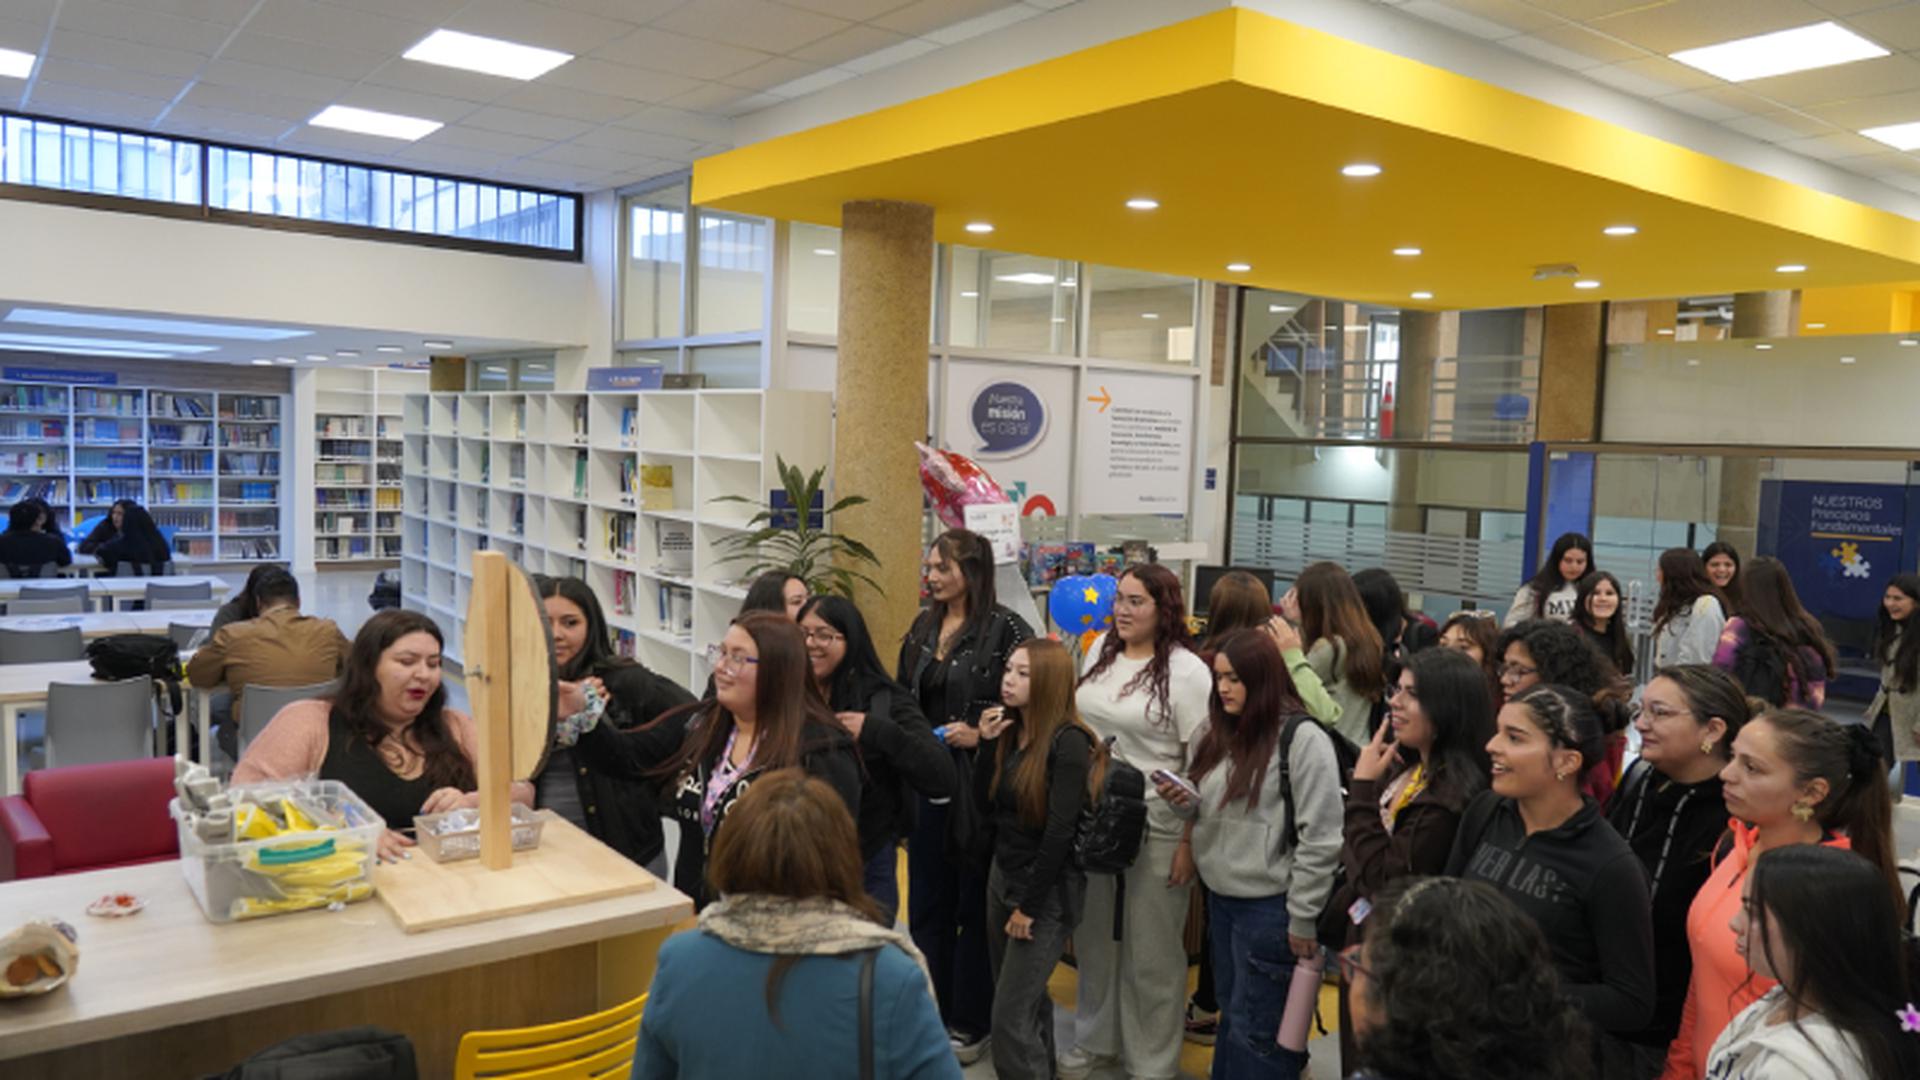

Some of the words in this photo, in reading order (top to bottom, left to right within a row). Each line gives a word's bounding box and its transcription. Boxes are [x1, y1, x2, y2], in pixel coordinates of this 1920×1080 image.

[988, 405, 1026, 421] misión
[1811, 494, 1883, 510] NUESTROS
[1810, 508, 1871, 522] Principios
[1810, 520, 1903, 535] Fundamentales
